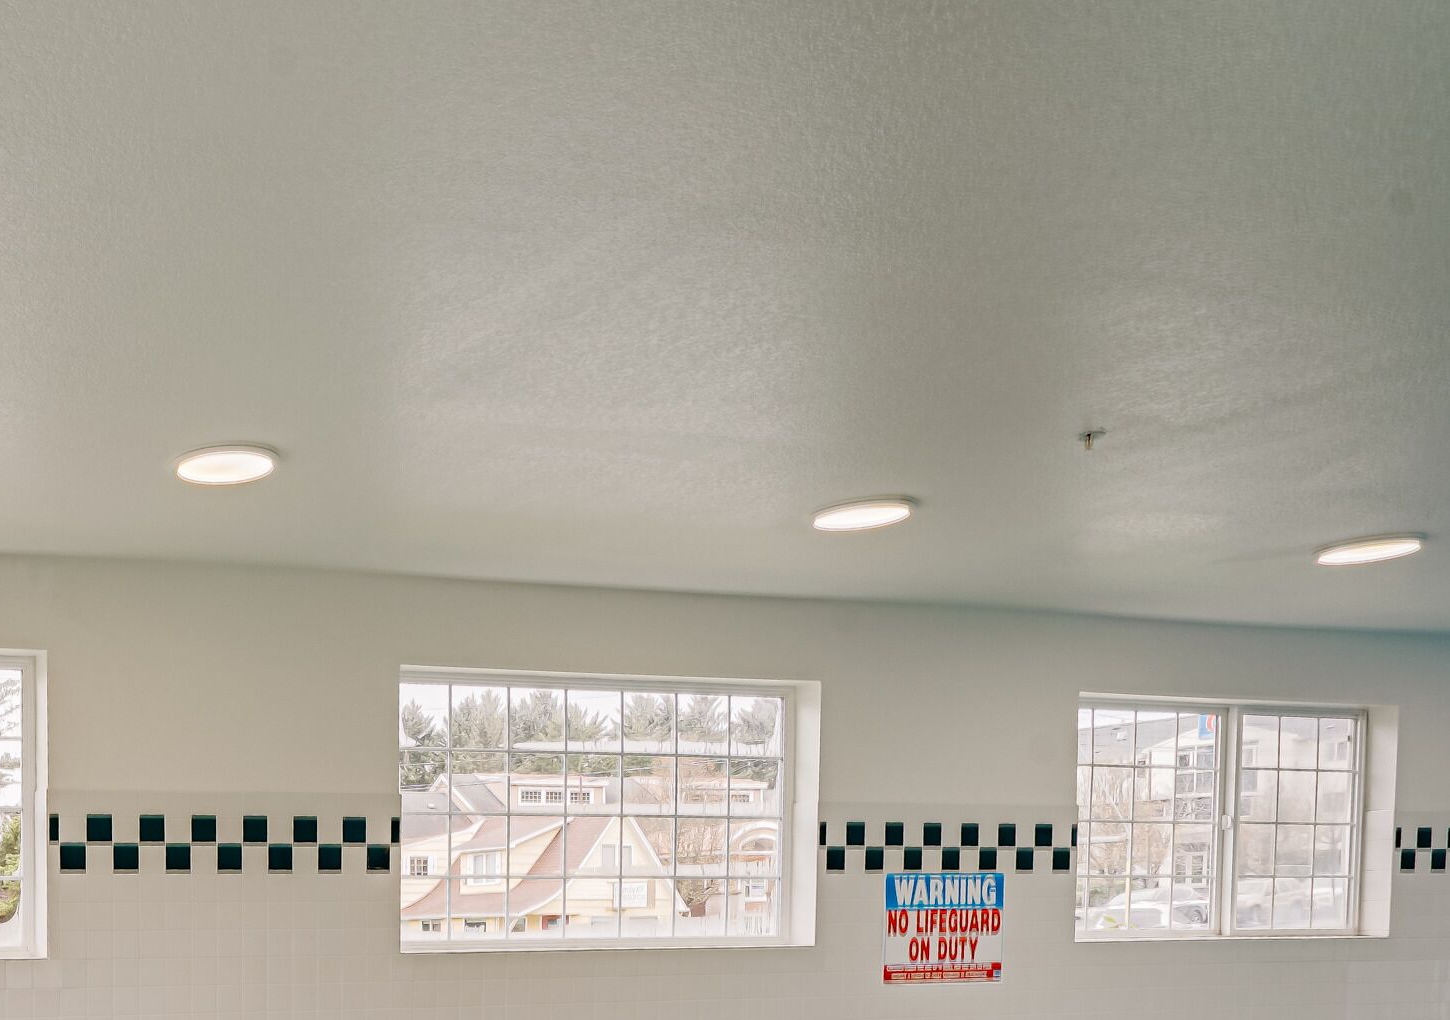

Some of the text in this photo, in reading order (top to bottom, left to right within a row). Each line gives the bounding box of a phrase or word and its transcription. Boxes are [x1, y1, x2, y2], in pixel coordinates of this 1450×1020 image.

[894, 875, 997, 906] WARNING
[887, 908, 1001, 934] NO LIFEGUARD
[908, 936, 978, 962] ON DUTY
